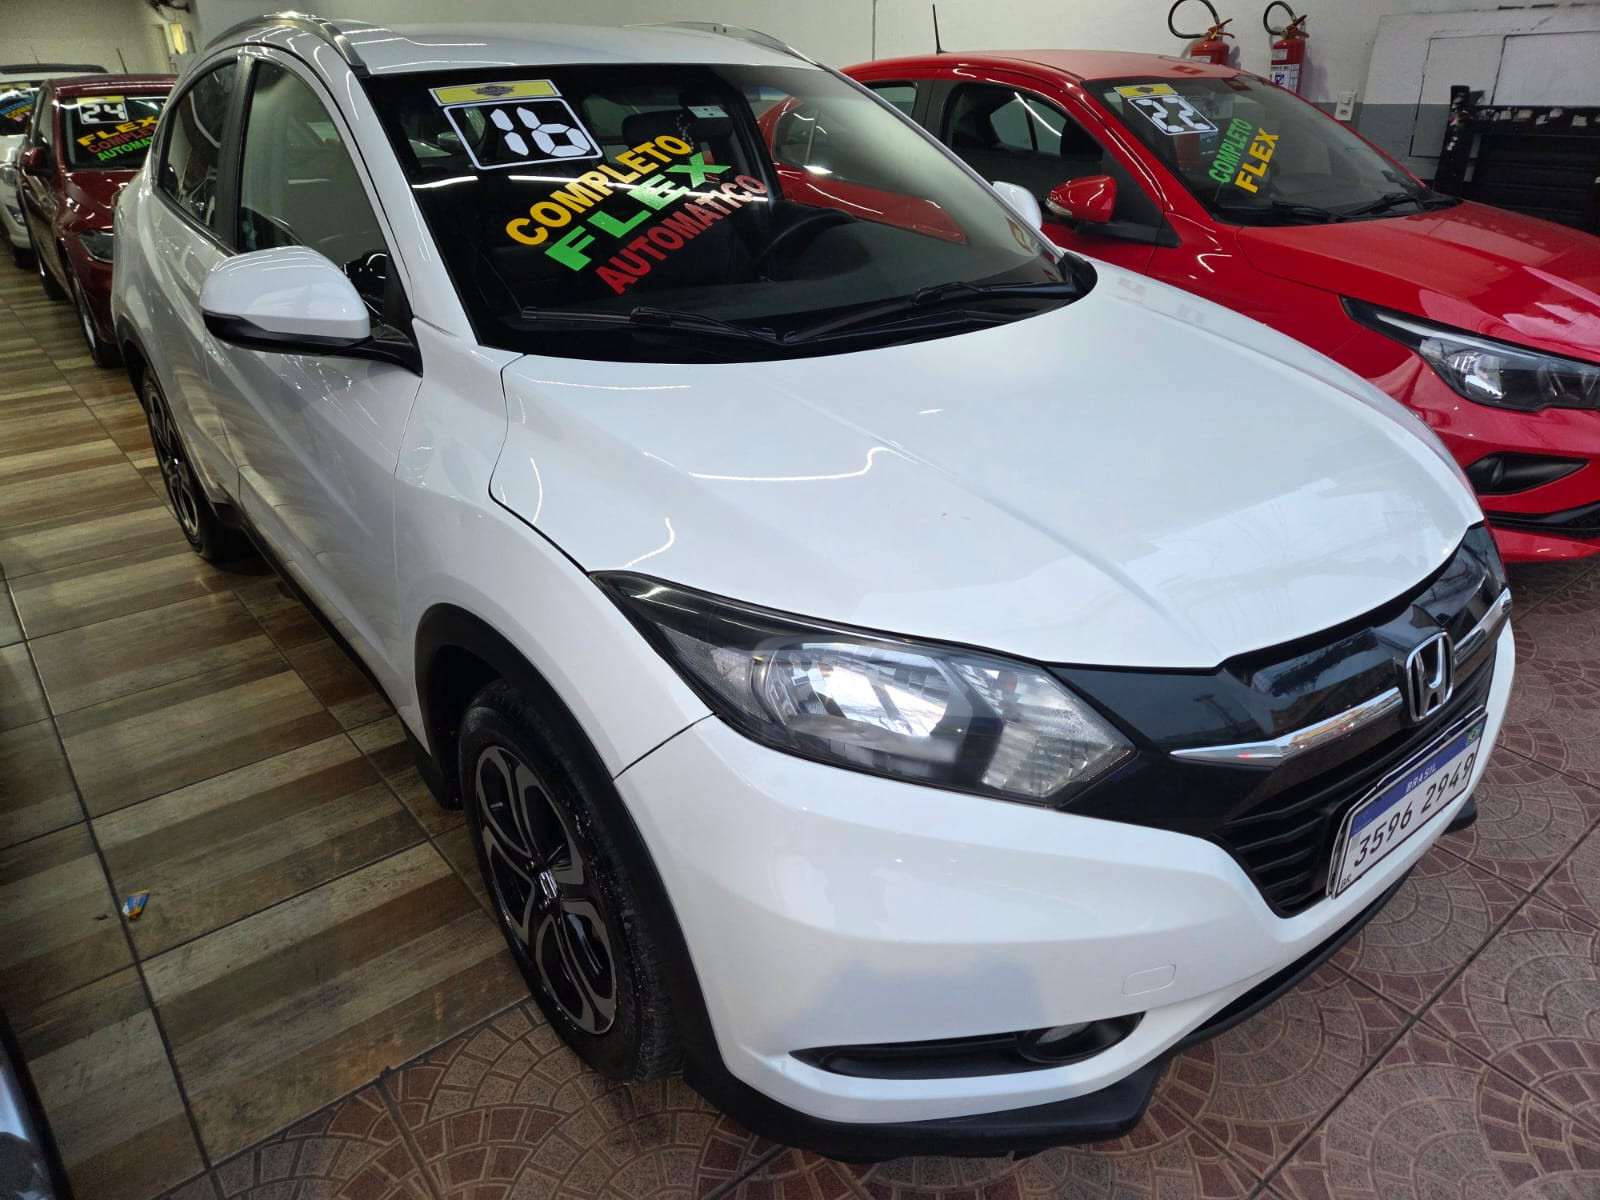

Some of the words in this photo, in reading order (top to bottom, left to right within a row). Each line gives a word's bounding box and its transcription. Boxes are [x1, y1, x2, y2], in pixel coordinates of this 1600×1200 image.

[77, 115, 158, 147] FLEX
[83, 103, 126, 122] 24
[490, 106, 591, 157] 16
[1135, 97, 1211, 133] 22
[1208, 117, 1254, 184] COMPLETO
[1234, 127, 1280, 194] FLEX
[506, 135, 692, 246] COMPLETO
[544, 151, 732, 272] FLEX
[595, 174, 768, 295] AUTOMATICO
[1354, 800, 1413, 868] 3596
[1420, 752, 1475, 815] 2949
[1405, 761, 1437, 793] BRASIL
